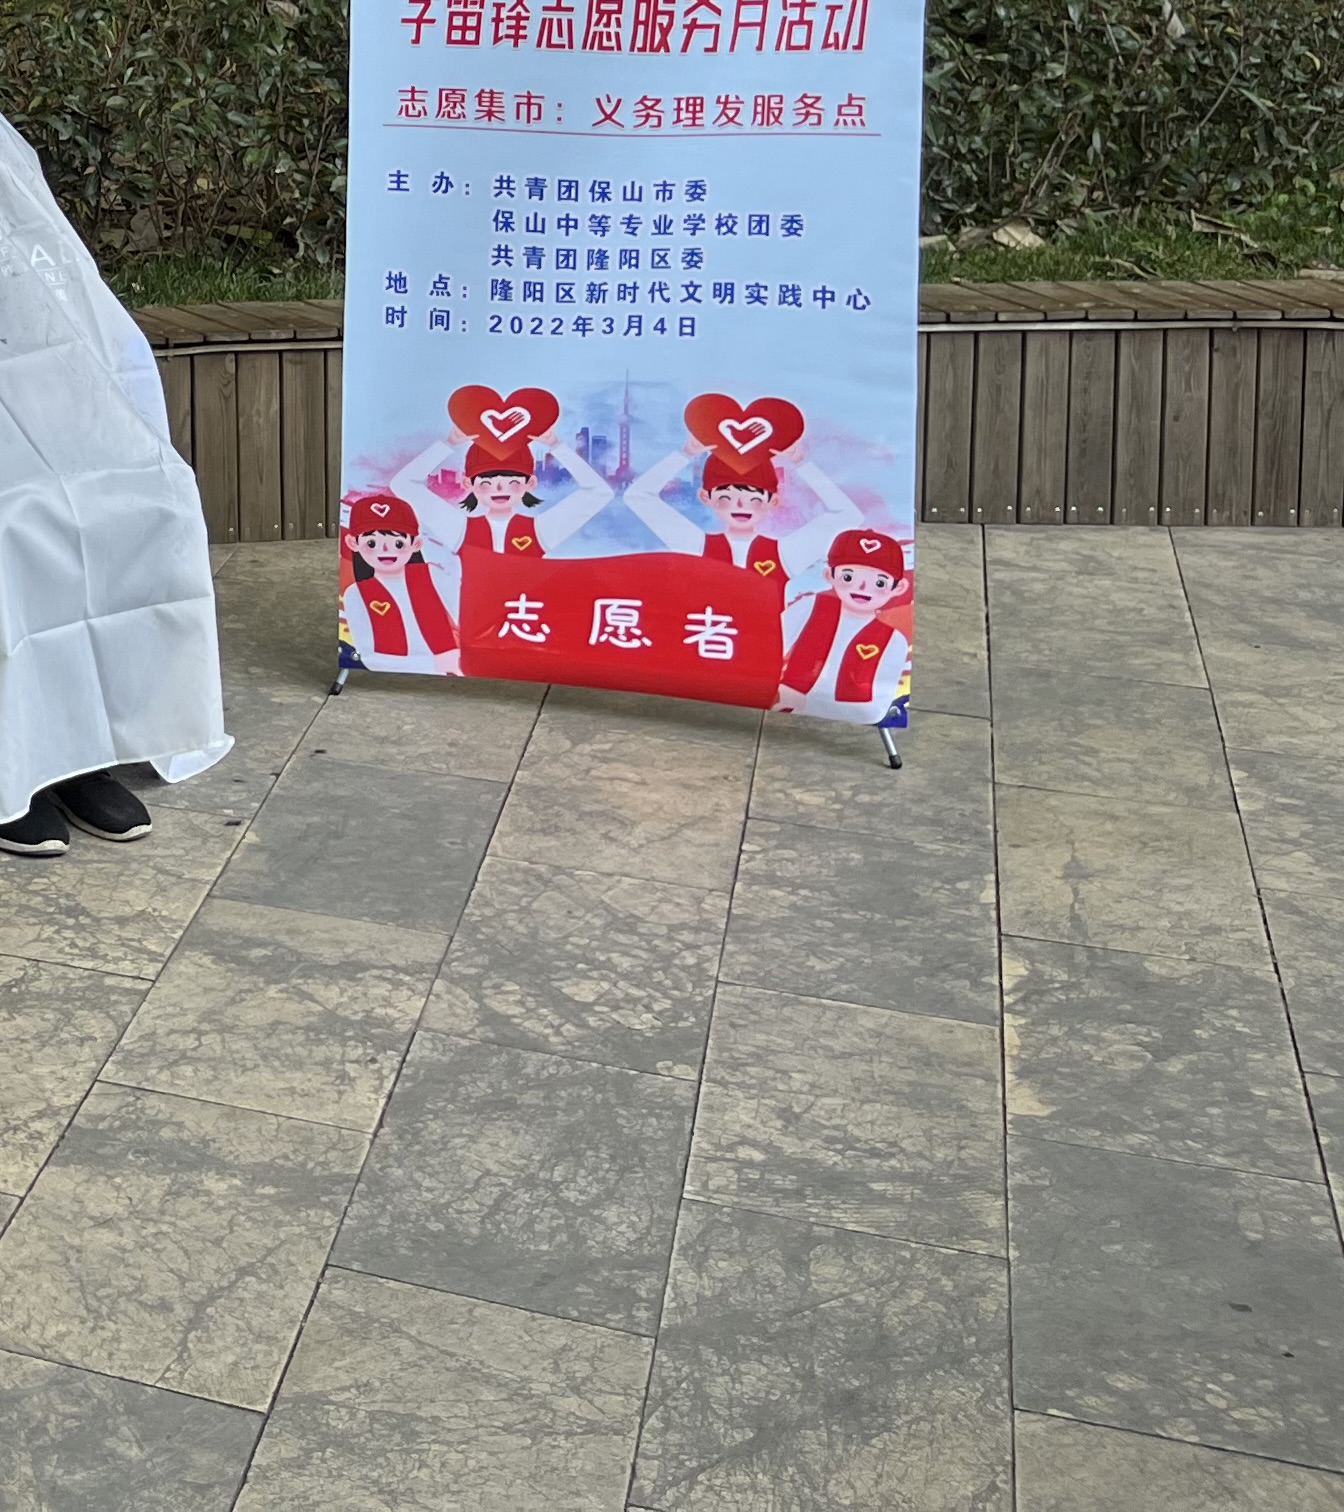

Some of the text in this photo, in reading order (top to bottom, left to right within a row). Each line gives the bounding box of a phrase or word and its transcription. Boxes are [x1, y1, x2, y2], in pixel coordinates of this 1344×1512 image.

[492, 210, 805, 238] 保山中等专业学校团委
[491, 245, 705, 272] 共青团隆阳区委
[498, 593, 738, 660] 志愿者
